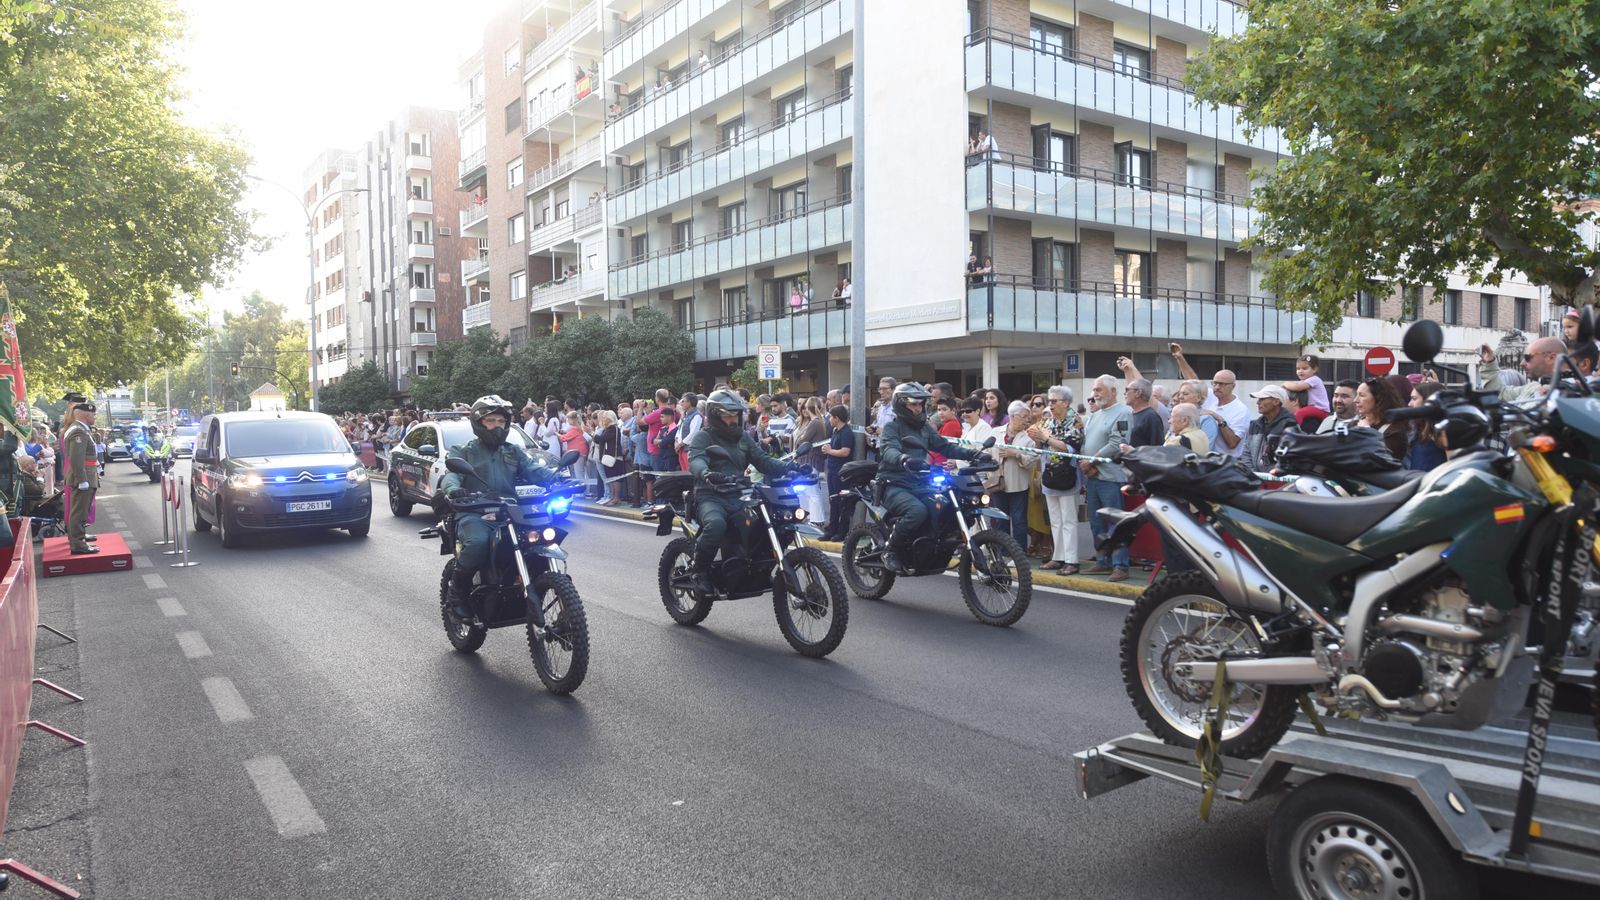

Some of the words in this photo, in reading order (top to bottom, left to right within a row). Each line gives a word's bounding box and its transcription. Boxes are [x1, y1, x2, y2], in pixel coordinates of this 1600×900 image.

[291, 503, 305, 512] PGC
[305, 502, 325, 511] 2611
[1523, 723, 1547, 788] SPORT
